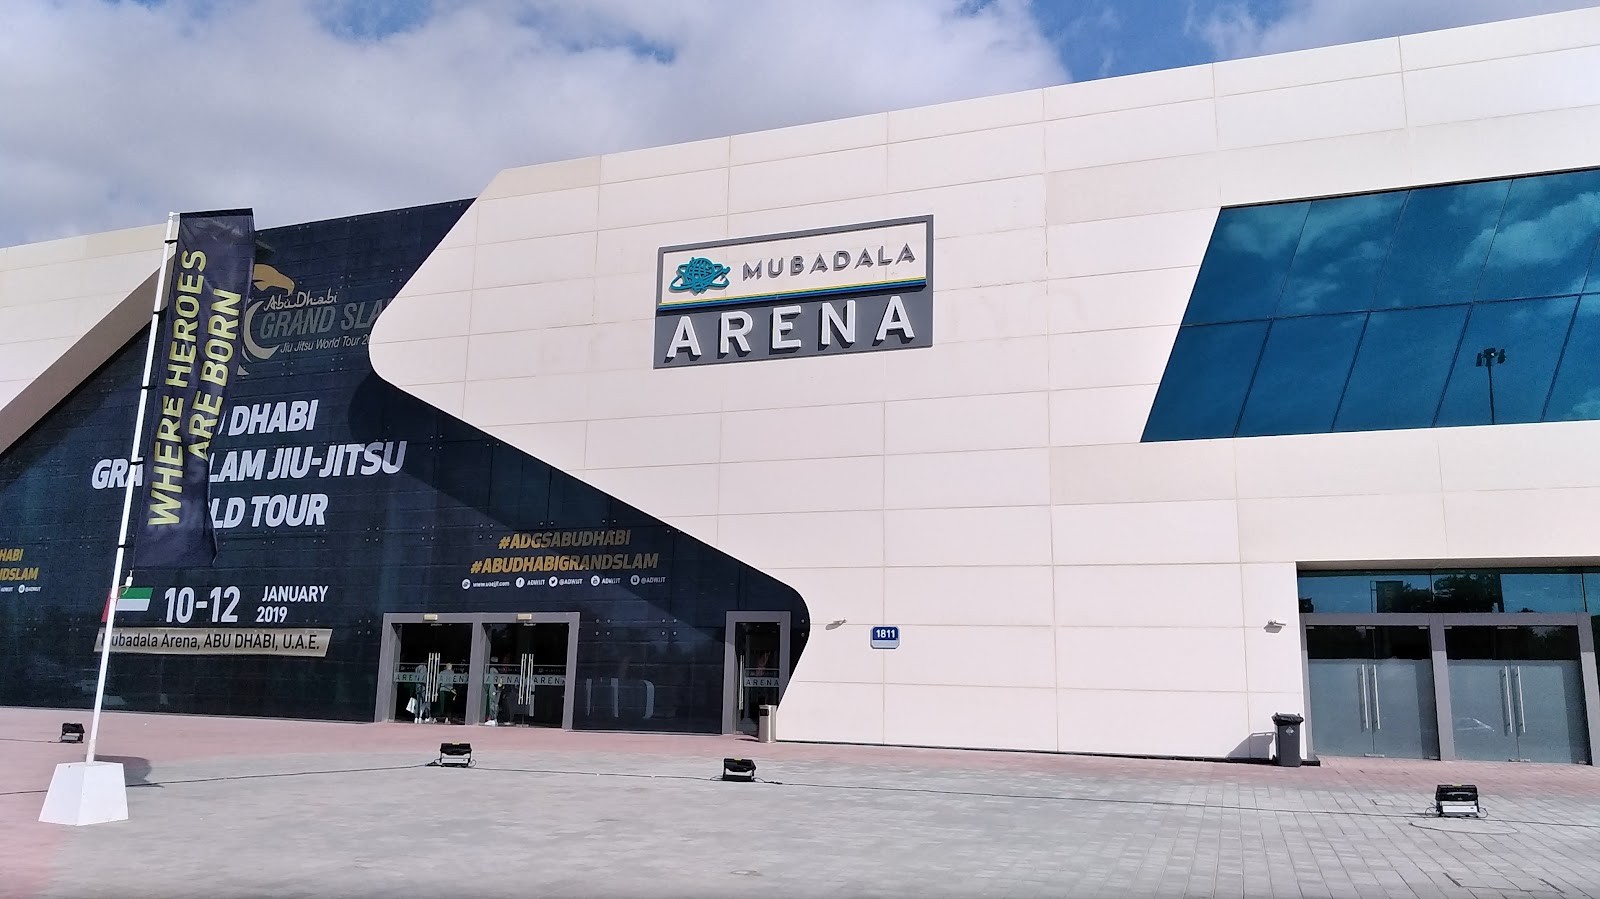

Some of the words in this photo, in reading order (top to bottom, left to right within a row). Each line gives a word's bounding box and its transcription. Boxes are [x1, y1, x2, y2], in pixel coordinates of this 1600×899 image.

[742, 243, 916, 282] MUBADALA
[164, 250, 207, 388] HEROES
[200, 288, 242, 387] BORN
[259, 306, 337, 340] GRAND
[340, 298, 392, 331] SLA
[665, 295, 916, 363] ARENA
[280, 342, 293, 354] Jiu
[294, 340, 314, 353] Jitsu
[316, 336, 342, 350] World
[343, 334, 361, 348] Tour
[188, 390, 224, 462] ARE
[227, 399, 320, 437] DHABI
[91, 457, 144, 490] GRA
[208, 449, 267, 483] LAM
[266, 440, 408, 480] JIU-JITSU
[147, 395, 185, 526] WHERE
[251, 493, 329, 528] TOUR
[498, 529, 632, 549] #ADGSABUDHABI
[470, 552, 659, 574] #ABUDHABIGRANDSLAM
[164, 585, 242, 623] 10-12
[261, 585, 329, 603] JANUARY
[255, 606, 288, 623] 2019
[161, 633, 201, 650] Arena,
[203, 633, 233, 649] ABU
[234, 633, 279, 651] DHABI,
[282, 634, 321, 650] U.A.E.
[876, 629, 896, 638] 1811
